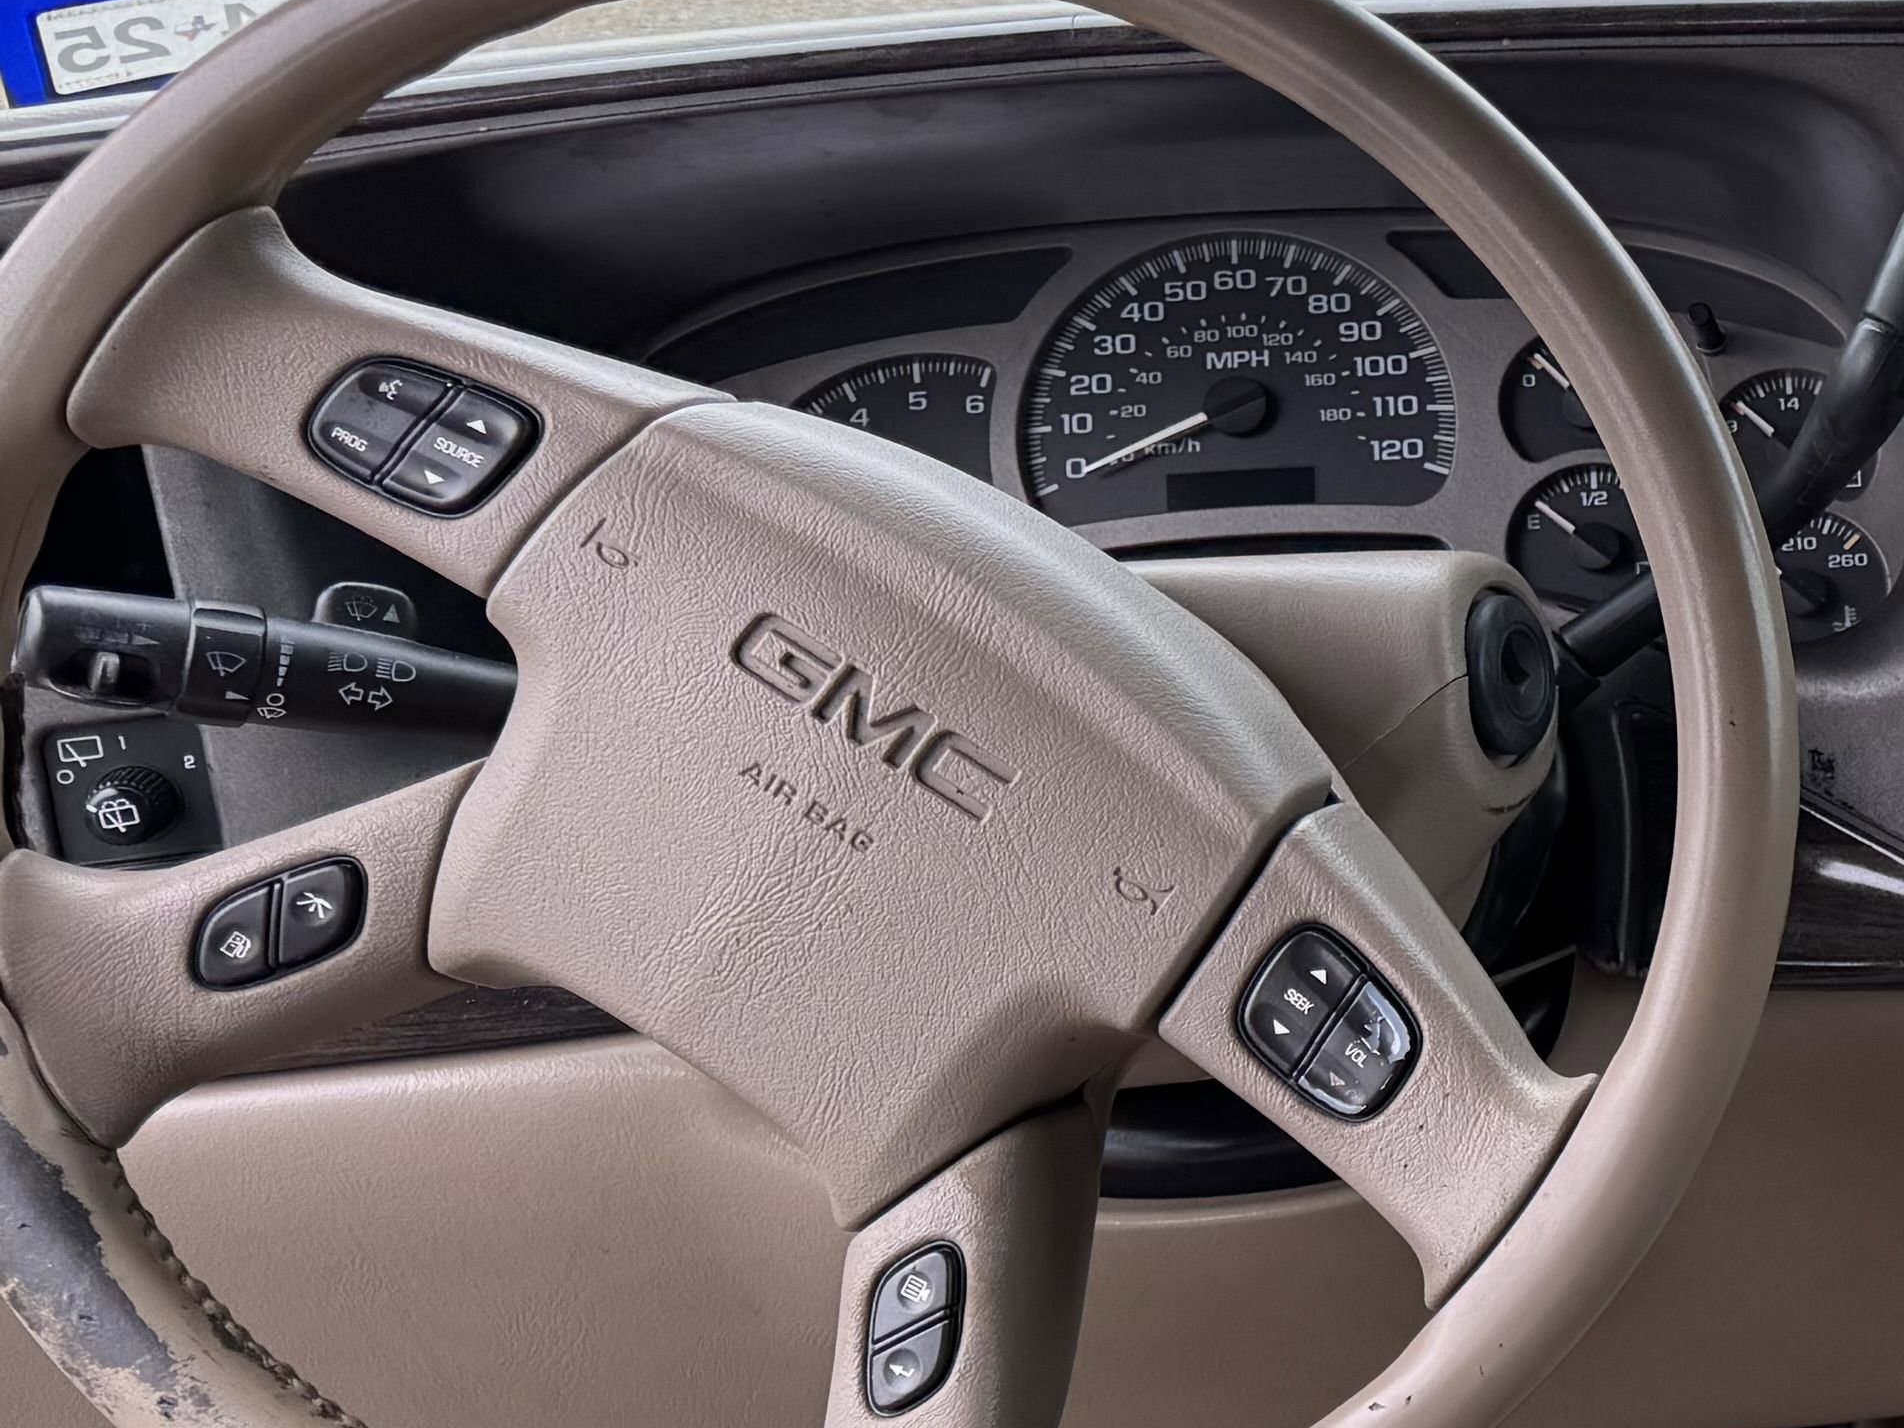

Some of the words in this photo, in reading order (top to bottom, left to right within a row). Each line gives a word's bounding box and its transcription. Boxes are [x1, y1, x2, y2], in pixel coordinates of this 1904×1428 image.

[1213, 269, 1257, 290] 60
[1265, 276, 1307, 297] 70
[1164, 280, 1207, 302] 50
[1120, 301, 1165, 323] 40
[1308, 293, 1351, 314] 80
[1193, 329, 1220, 343] 80
[1225, 325, 1258, 339] 100
[1262, 333, 1293, 346] 120
[1339, 321, 1382, 342] 90
[1093, 334, 1136, 355] 30
[1166, 345, 1192, 358] 60
[1206, 349, 1270, 370] MPH
[1285, 351, 1317, 364] 140
[1353, 354, 1408, 377] 100
[1070, 374, 1112, 395] 20
[1135, 371, 1162, 385] 40
[1304, 373, 1336, 386] 160
[908, 391, 927, 411] 5
[965, 395, 984, 414] 6
[1120, 404, 1147, 418] 20
[1372, 395, 1419, 417] 110
[1778, 398, 1800, 411] 14
[850, 407, 870, 427] 4
[1060, 413, 1093, 435] 10
[1320, 408, 1351, 422] 180
[331, 427, 369, 452] PROG
[1370, 438, 1424, 461] 120
[433, 437, 485, 468] SOURCE
[1065, 457, 1087, 479] 0
[1580, 491, 1608, 508] 1/2
[1527, 514, 1541, 530] E
[1781, 536, 1817, 552] 210
[1828, 553, 1868, 568] 260
[729, 612, 1022, 823] GMC
[183, 755, 197, 769] 2
[738, 762, 798, 806] AIR
[804, 800, 874, 853] BAG
[1283, 988, 1315, 1015] SEEK
[1345, 1043, 1369, 1069] VOL
